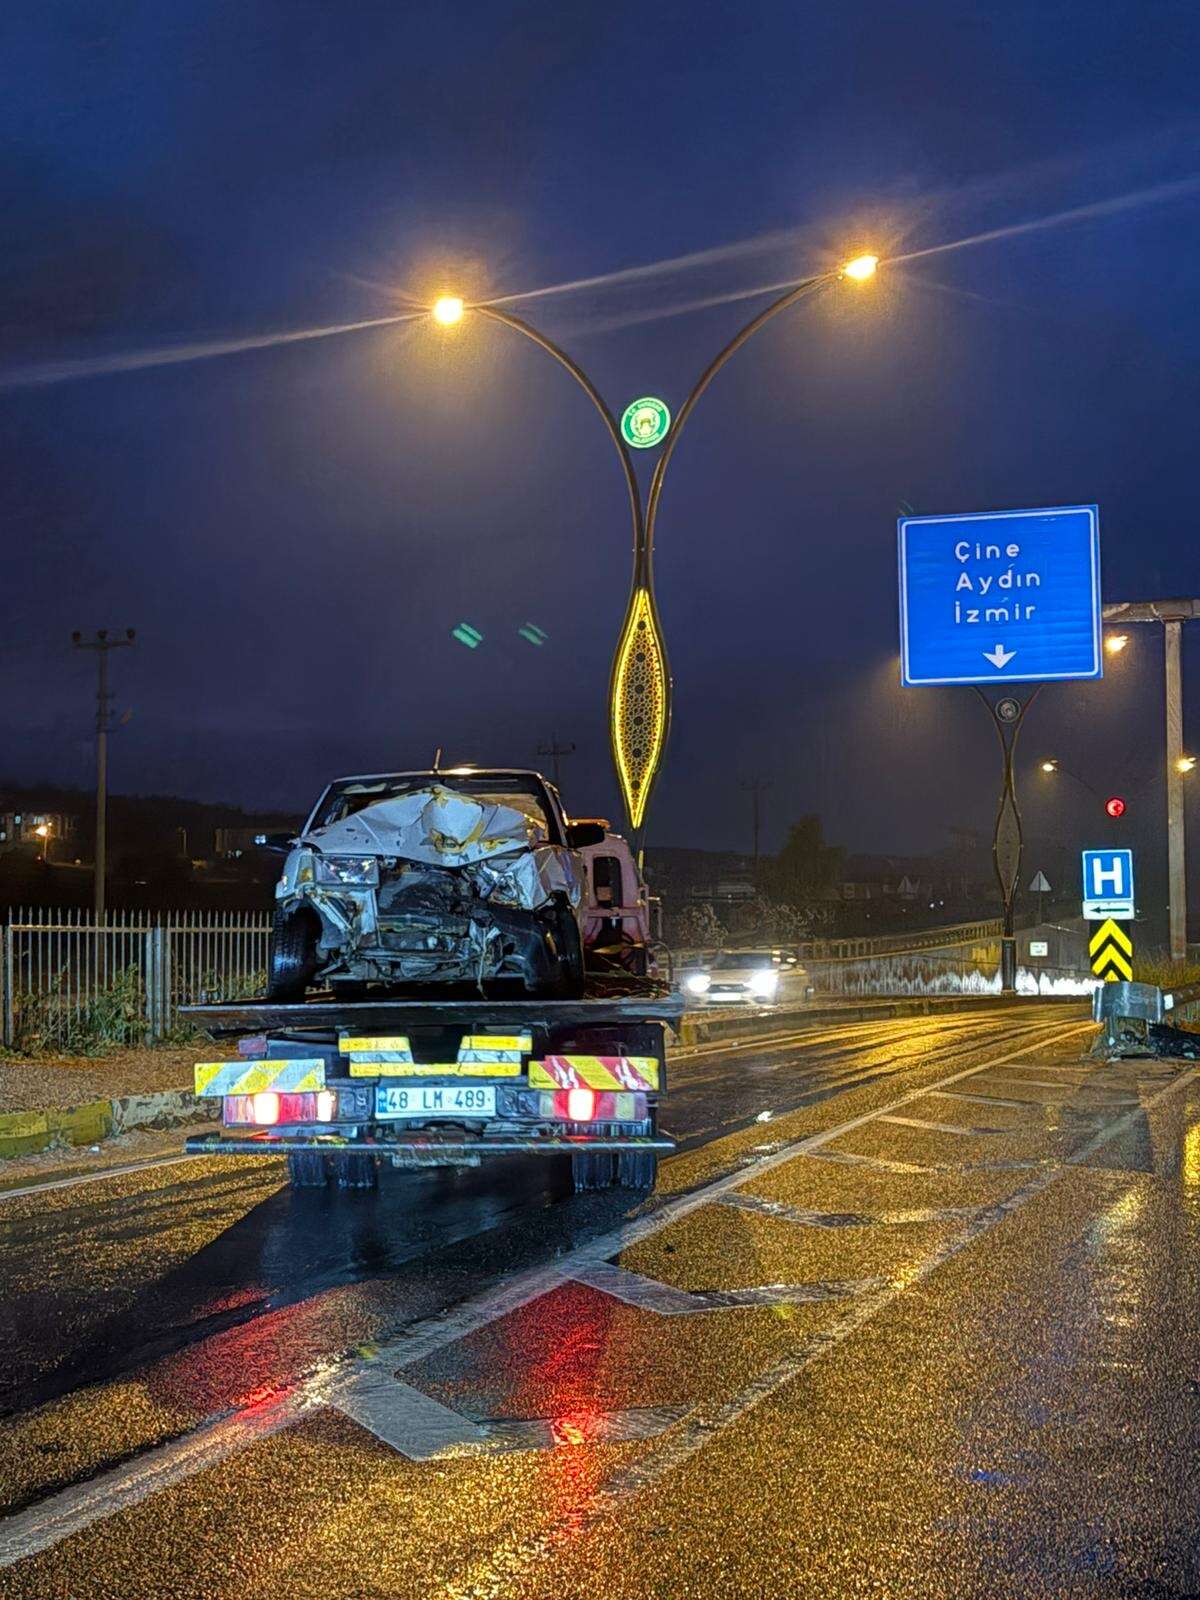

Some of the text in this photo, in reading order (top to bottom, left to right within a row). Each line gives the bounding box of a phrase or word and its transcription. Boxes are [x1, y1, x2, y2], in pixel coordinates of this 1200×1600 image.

[954, 541, 1020, 563] Çine
[955, 570, 1041, 595] Aydın
[954, 601, 1036, 624] İzmir
[1092, 857, 1123, 895] H
[388, 1089, 486, 1109] 48 LM 489
